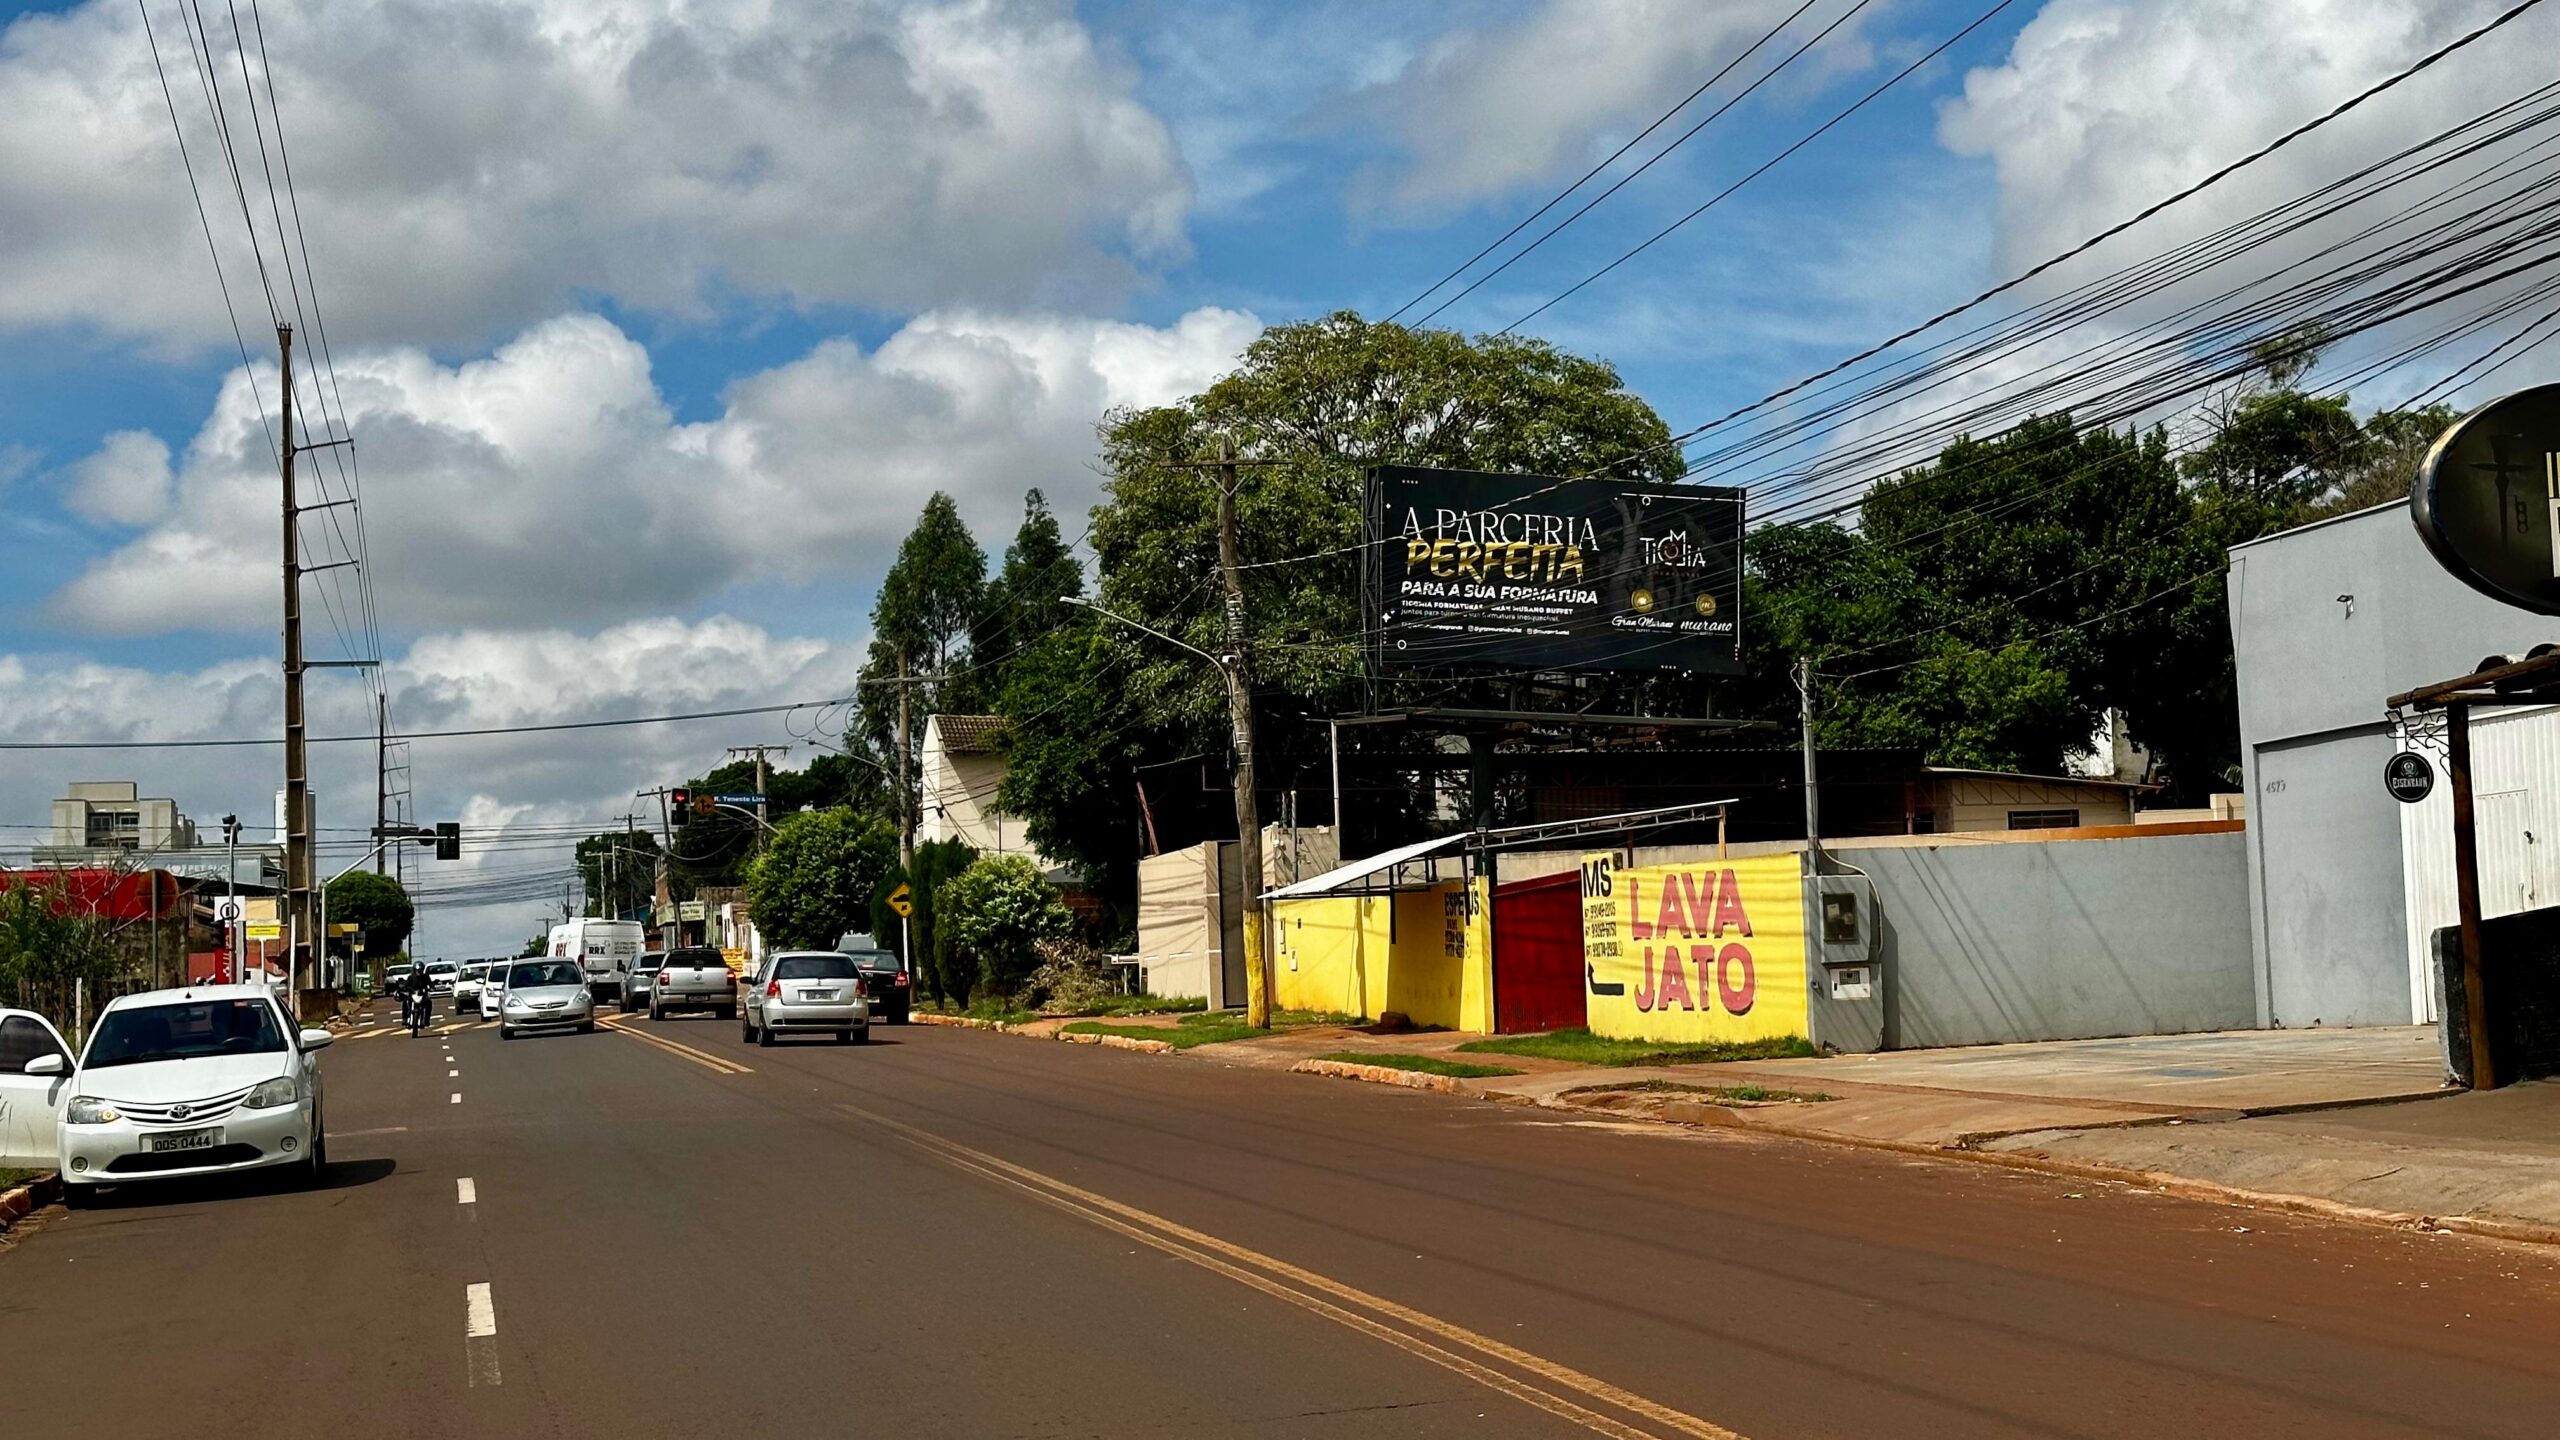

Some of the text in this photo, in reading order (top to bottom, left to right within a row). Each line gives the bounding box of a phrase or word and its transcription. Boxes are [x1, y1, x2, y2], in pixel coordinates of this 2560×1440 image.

[1402, 506, 1600, 551] A PARCERIA
[1405, 538, 1585, 585] PERFEITA
[1401, 580, 1598, 604] PARA A SUA FORMATURA
[1546, 607, 1574, 615] BUFFET
[1611, 615, 1637, 627] Gran
[1680, 620, 1733, 632] murano
[1582, 858, 1612, 898] MS
[1630, 868, 1754, 941] LAVA
[1634, 942, 1756, 1016] JATO
[180, 1135, 210, 1149] 0444
